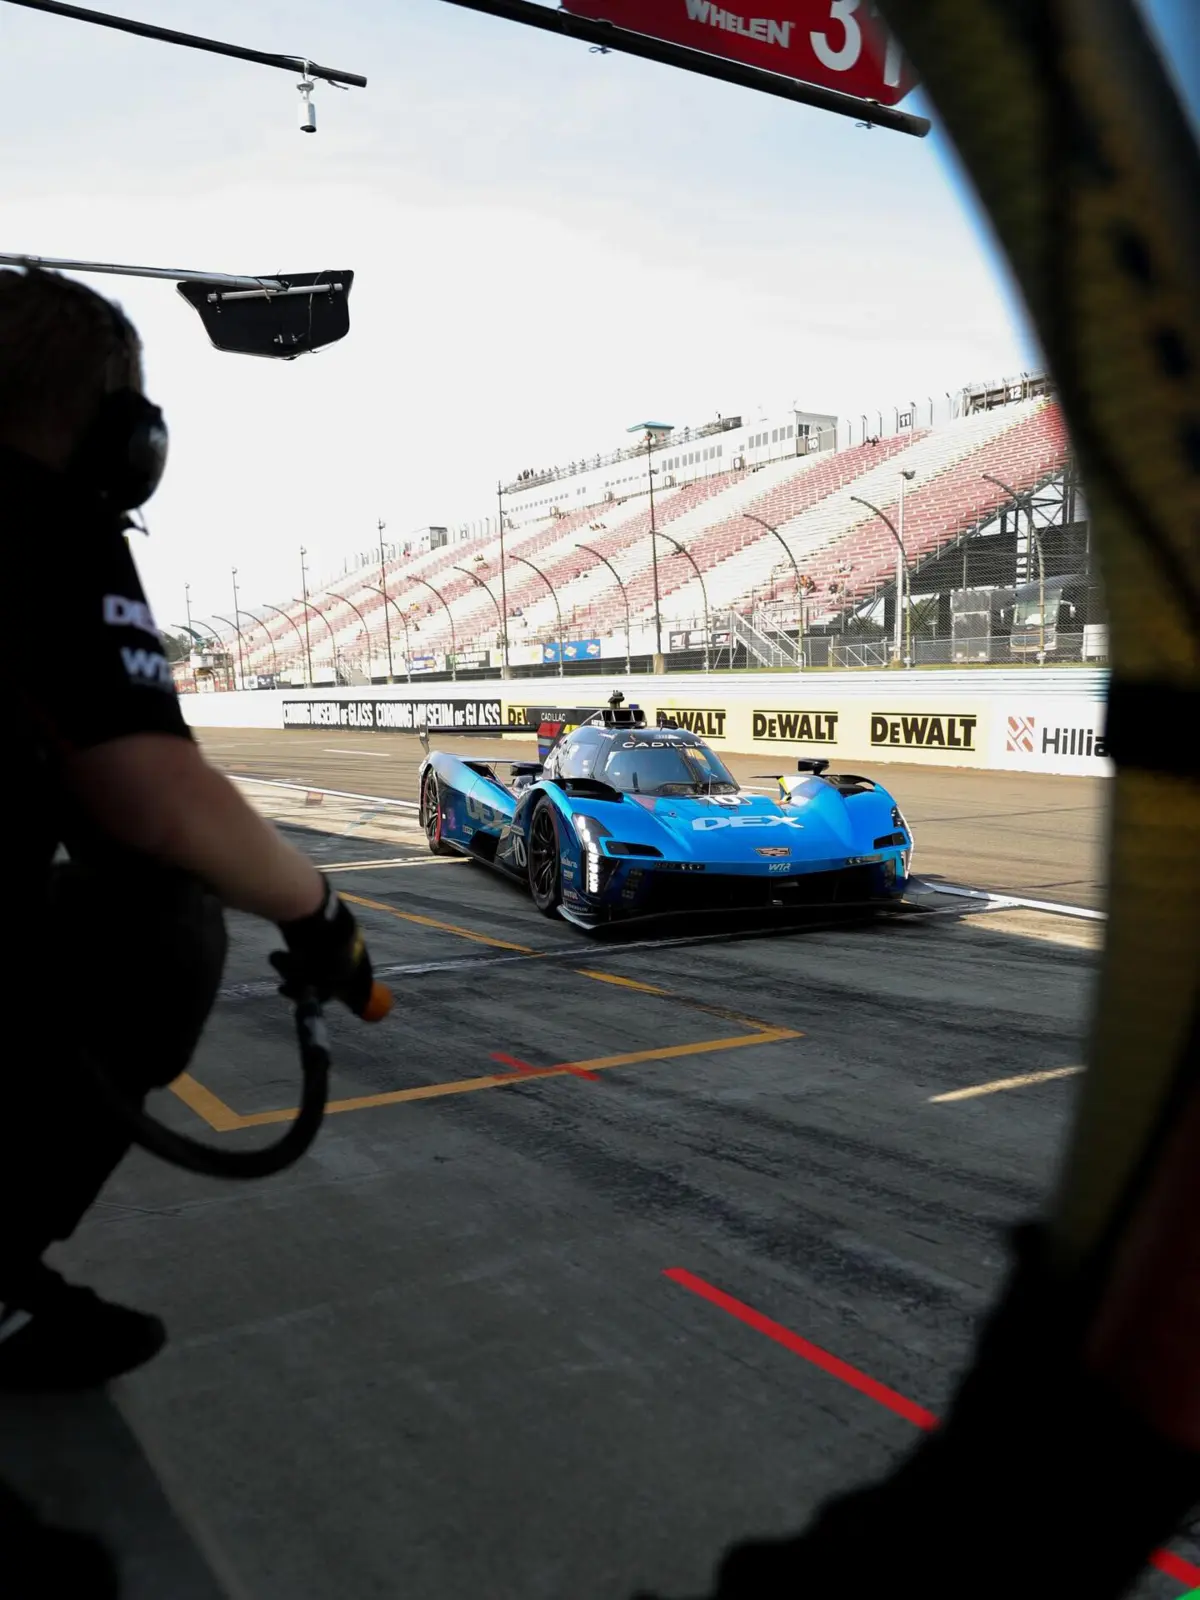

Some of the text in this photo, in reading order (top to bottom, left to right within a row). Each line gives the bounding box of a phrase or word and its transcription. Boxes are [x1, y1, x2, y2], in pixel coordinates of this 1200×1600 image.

[685, 0, 790, 48] WHELEN
[1009, 387, 1021, 399] 12
[901, 415, 911, 427] 11
[348, 703, 372, 726] GLASS
[376, 703, 412, 728] CORNING
[413, 703, 454, 728] MUSEUM
[466, 703, 500, 726] GLASS
[541, 712, 566, 722] CADILLAC
[691, 815, 804, 831] DEX
